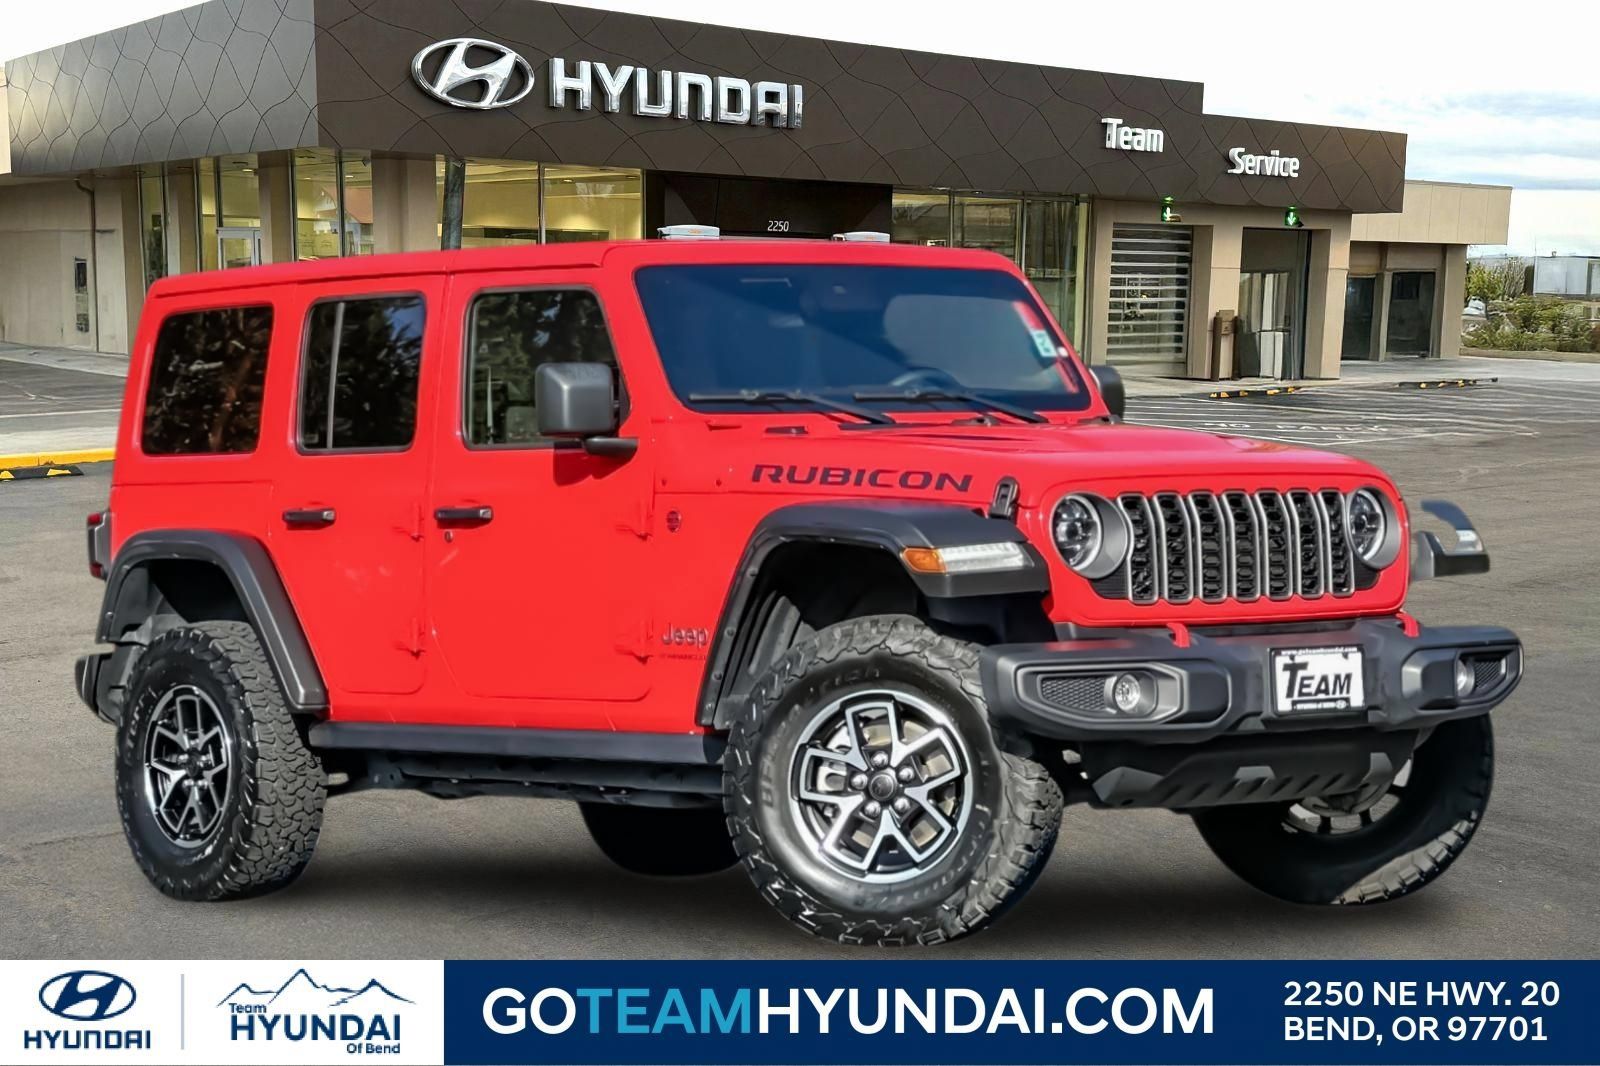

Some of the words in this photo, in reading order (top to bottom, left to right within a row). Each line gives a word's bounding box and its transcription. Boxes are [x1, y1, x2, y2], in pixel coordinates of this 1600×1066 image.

[549, 57, 803, 129] HYUNDAI
[1102, 117, 1164, 153] Team
[1227, 147, 1300, 178] Service
[767, 219, 790, 233] 2250
[752, 464, 972, 492] RUBICON
[662, 622, 708, 651] Jeep
[1282, 661, 1353, 699] TEAM
